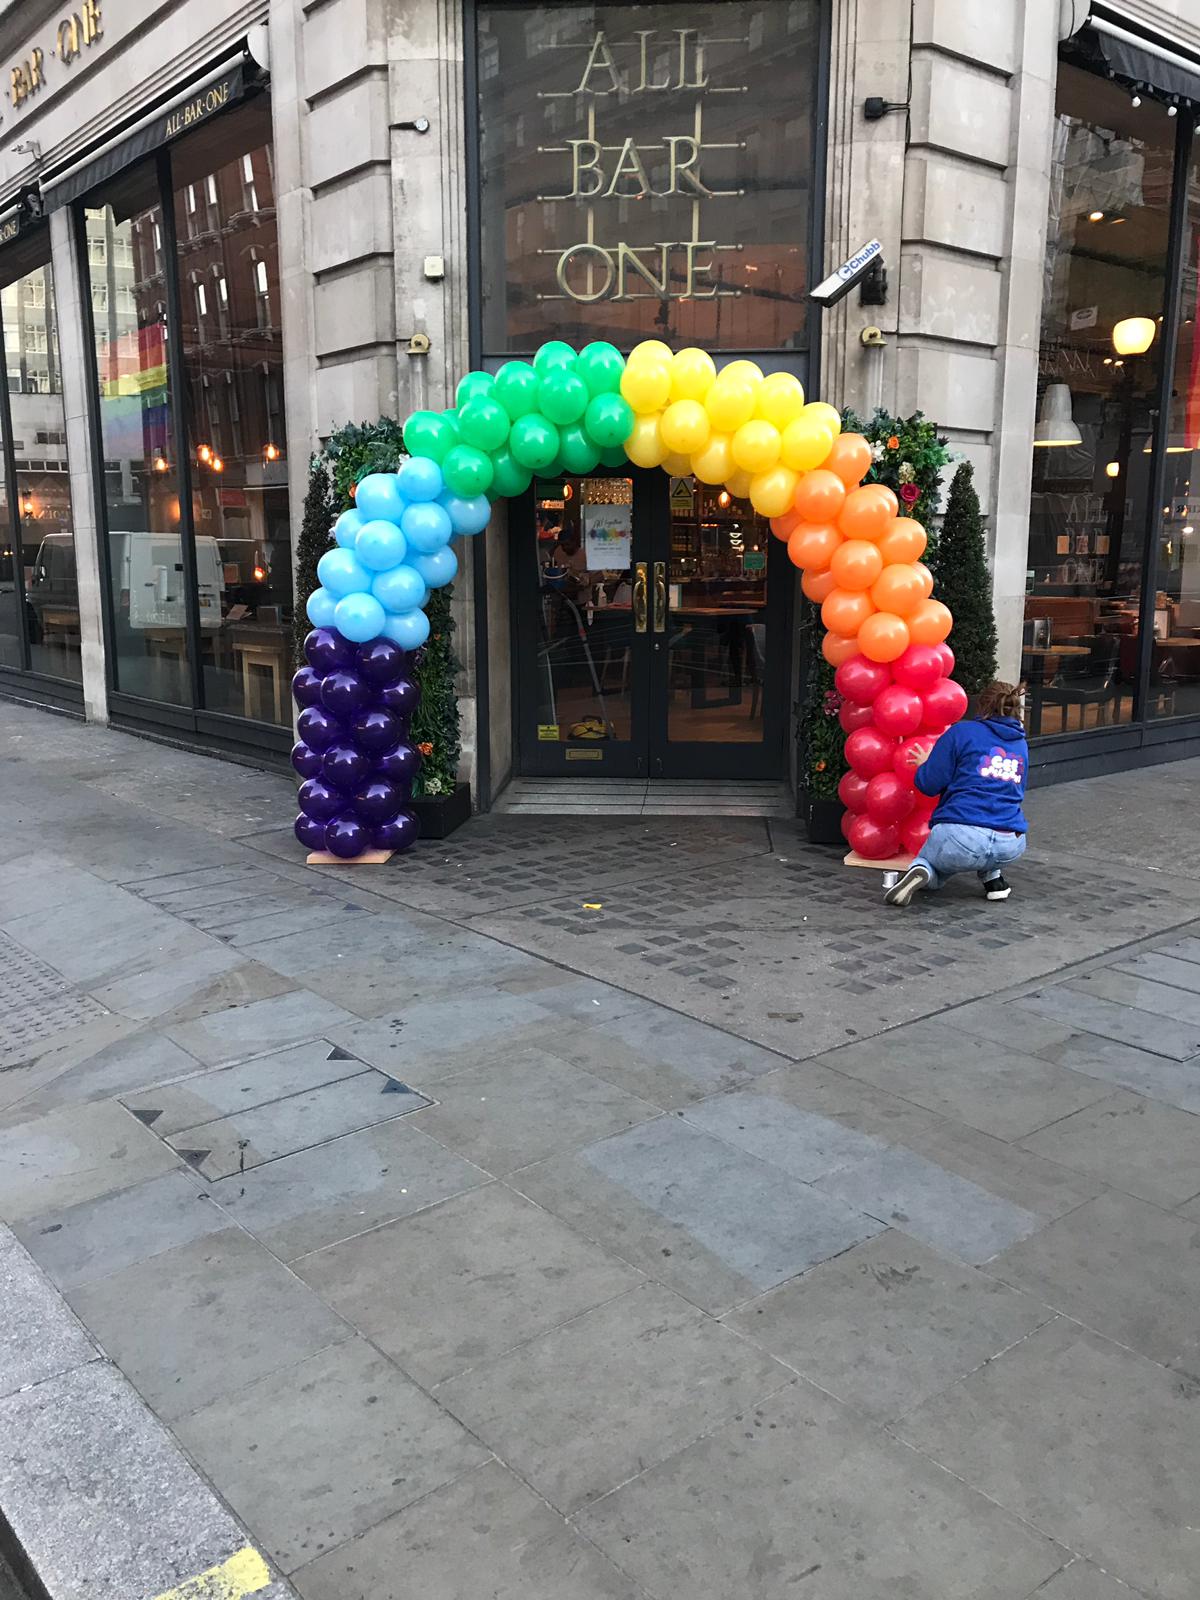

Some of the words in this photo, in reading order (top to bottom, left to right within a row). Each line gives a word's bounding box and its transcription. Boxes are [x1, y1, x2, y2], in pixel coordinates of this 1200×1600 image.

[10, 47, 46, 109] BAR
[57, 0, 104, 66] ONE
[571, 28, 710, 94] ALL
[565, 136, 714, 198] BAR
[556, 241, 717, 302] ONE
[849, 241, 881, 270] Chubb
